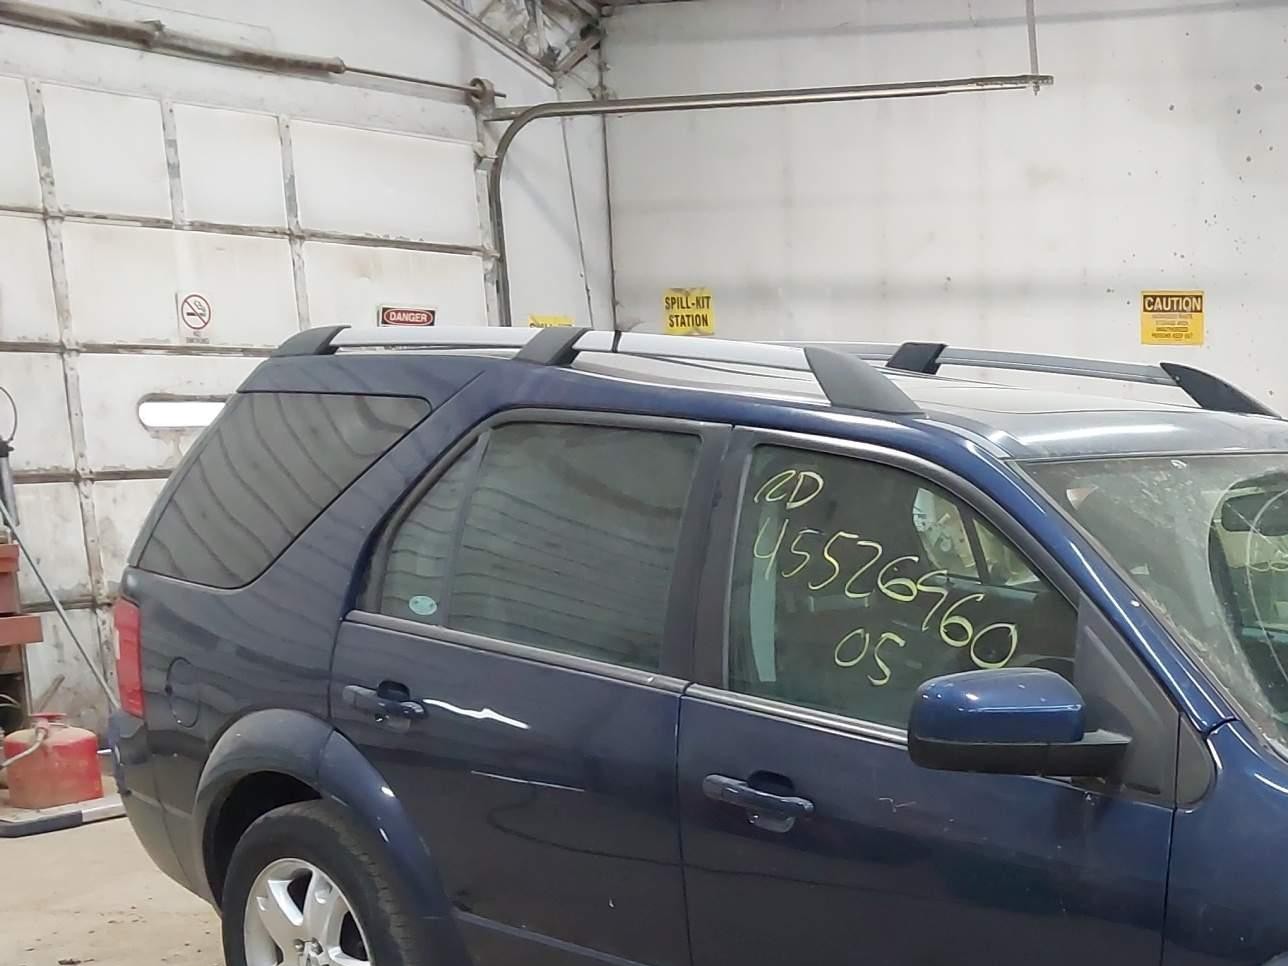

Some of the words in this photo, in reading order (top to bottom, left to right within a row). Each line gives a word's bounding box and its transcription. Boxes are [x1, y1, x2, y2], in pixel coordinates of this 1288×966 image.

[664, 296, 712, 310] SPILL-KIT
[1144, 296, 1202, 311] CAUTION
[389, 311, 428, 323] DANGER
[668, 313, 709, 328] STATION
[753, 516, 1018, 669] 45526960
